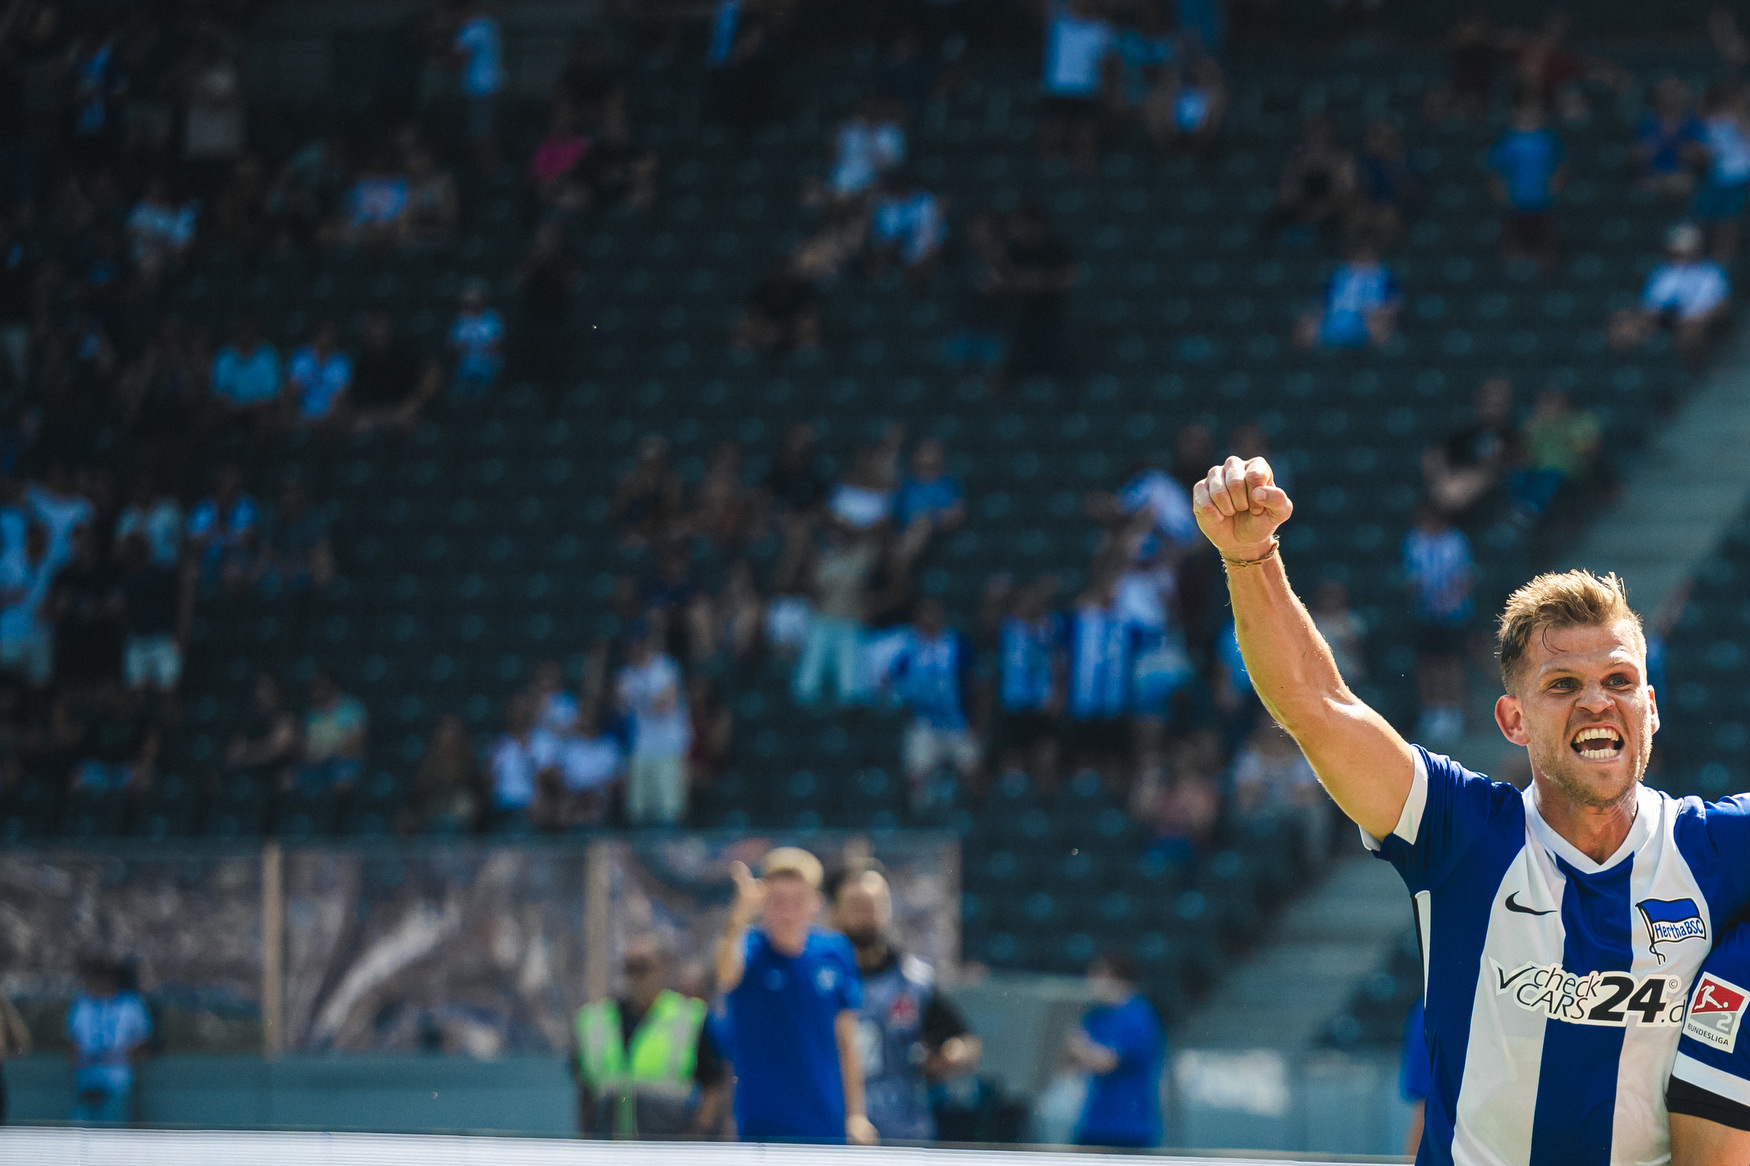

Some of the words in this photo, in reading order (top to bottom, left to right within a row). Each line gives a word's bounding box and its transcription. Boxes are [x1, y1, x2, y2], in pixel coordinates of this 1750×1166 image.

[1533, 967, 1601, 998] check
[1516, 983, 1589, 1020] CARS
[1687, 1022, 1729, 1047] BUNDESLIGA
[1716, 1012, 1733, 1031] 2
